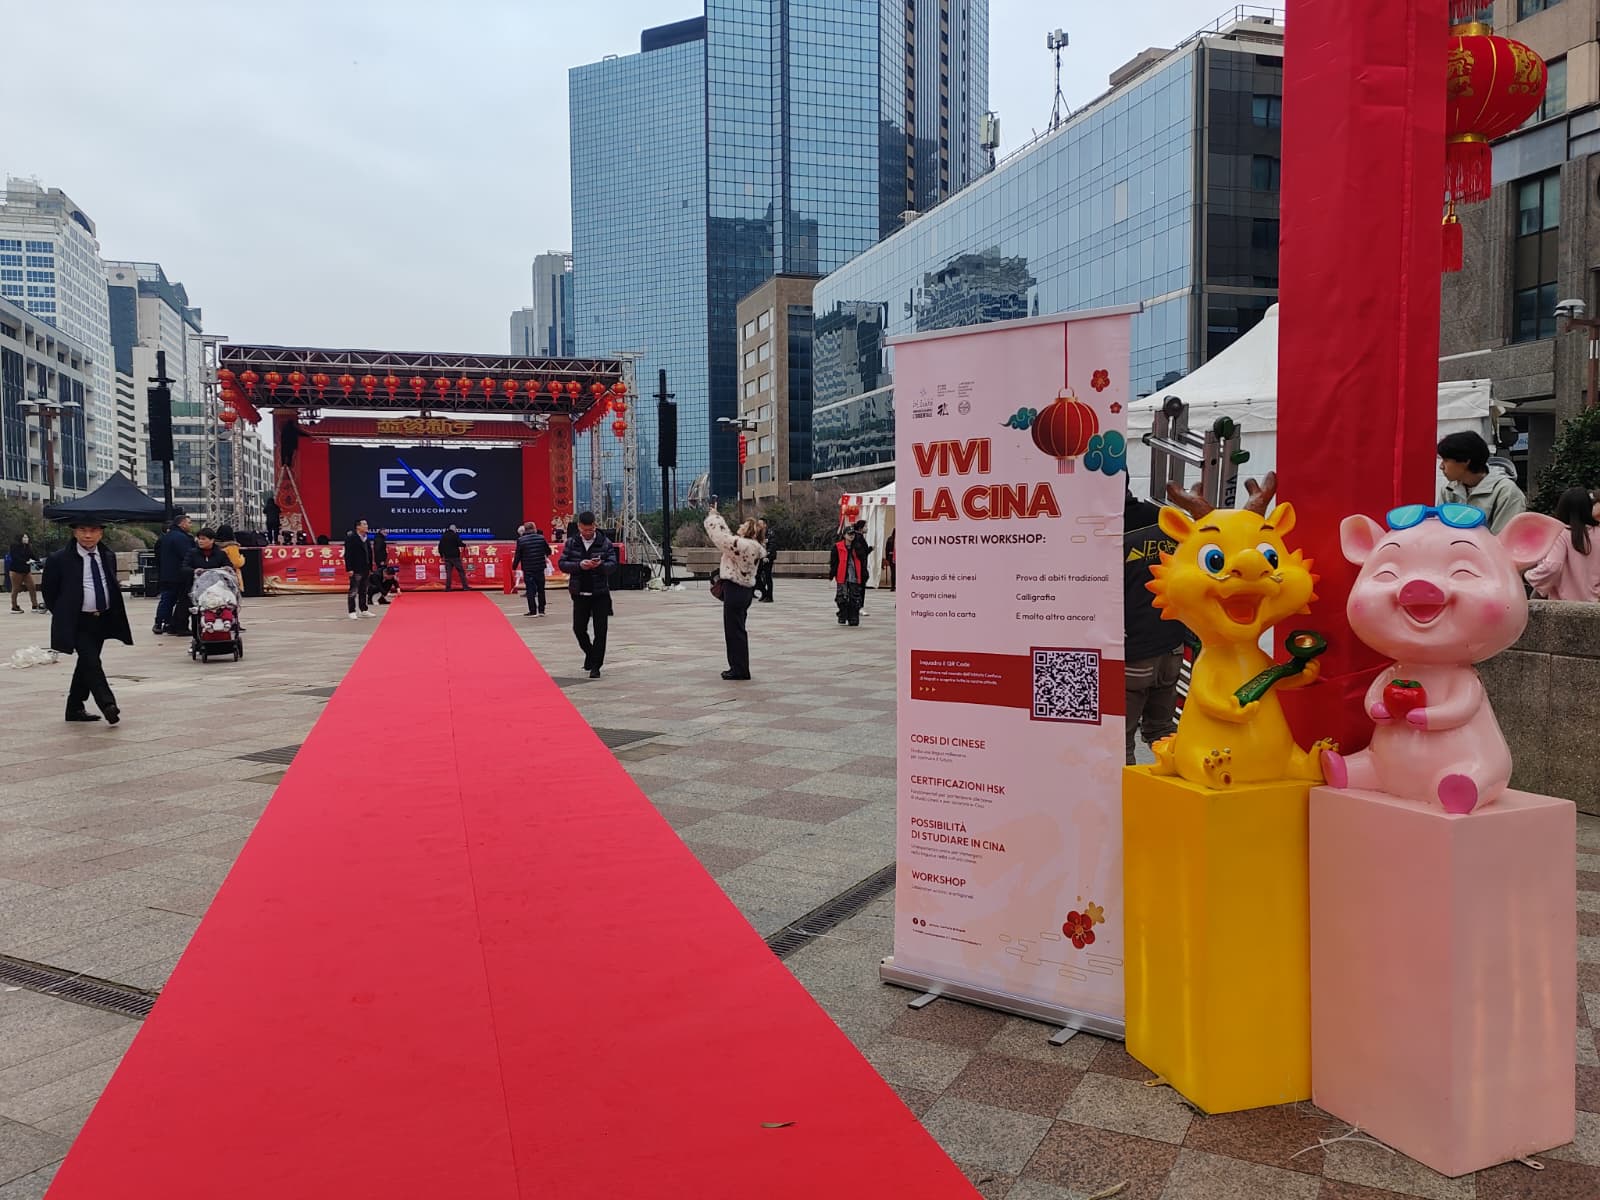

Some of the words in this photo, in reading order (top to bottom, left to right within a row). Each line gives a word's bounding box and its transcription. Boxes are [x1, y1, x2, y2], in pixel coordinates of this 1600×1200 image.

[912, 437, 991, 477] VIVI
[379, 468, 477, 500] EXC
[912, 486, 960, 522] LA
[961, 481, 1062, 521] CINA
[911, 536, 931, 545] CON
[933, 536, 937, 545] I
[939, 535, 978, 545] NOSTRI
[980, 534, 1046, 544] WORKSHOP:
[910, 574, 940, 582] Assaggio
[957, 574, 977, 582] cinesi
[1016, 574, 1037, 582] Prova
[1039, 574, 1047, 582] di
[1048, 574, 1066, 582] abiti
[1068, 574, 1109, 582] tradizionali
[910, 592, 937, 601] Origami
[937, 592, 957, 600] cinesi
[1016, 593, 1056, 603] Calligrafia
[910, 610, 934, 619] Intaglio
[949, 610, 956, 618] la
[957, 610, 976, 618] carta
[1016, 612, 1021, 620] E
[1022, 612, 1044, 621] molto
[1045, 612, 1065, 621] altro
[1067, 613, 1096, 622] ancora!
[956, 660, 971, 668] Code
[910, 733, 938, 746] CORSI
[939, 736, 950, 746] DI
[951, 737, 986, 750] CINESE
[910, 775, 985, 792] CERTIFICAZIONI
[986, 784, 1006, 795] HSK
[911, 817, 967, 833] POSSIBILITÀ
[911, 830, 920, 839] DI
[922, 832, 969, 847] STUDIARE
[970, 839, 981, 849] IN
[982, 841, 1006, 853] CINA
[911, 870, 966, 888] WORKSHOP
